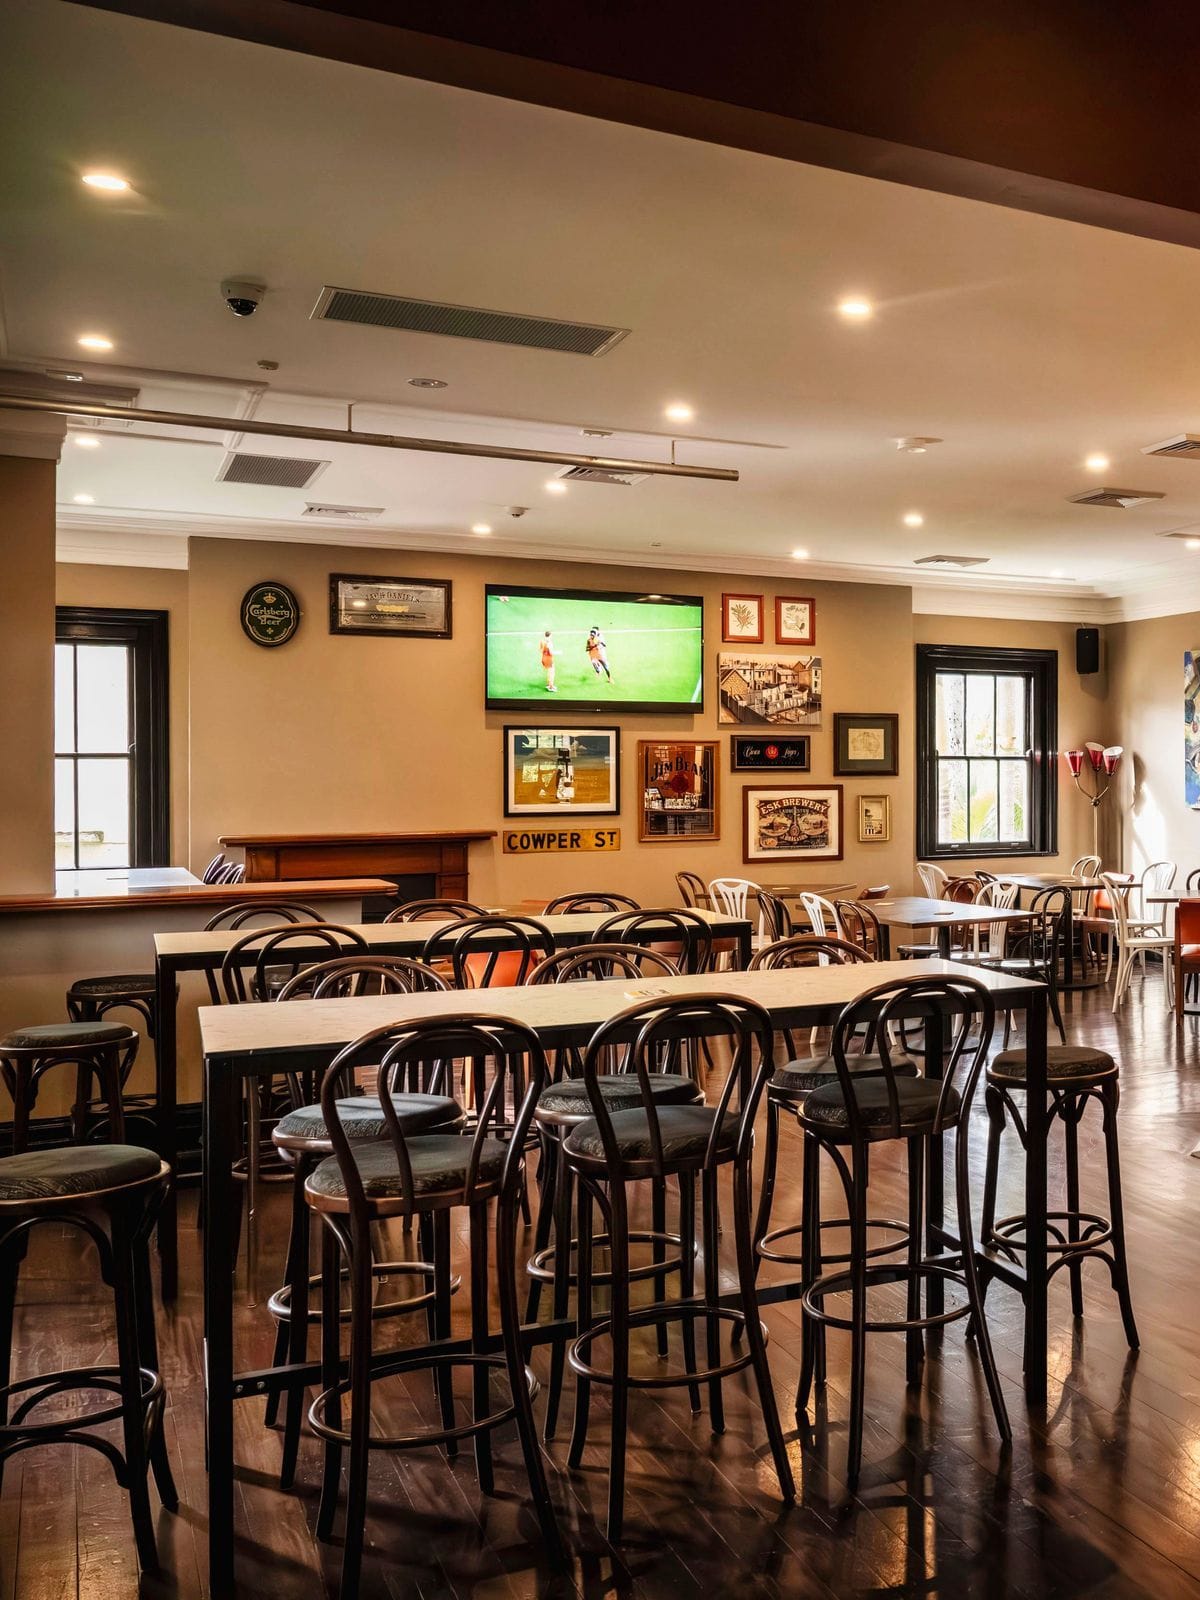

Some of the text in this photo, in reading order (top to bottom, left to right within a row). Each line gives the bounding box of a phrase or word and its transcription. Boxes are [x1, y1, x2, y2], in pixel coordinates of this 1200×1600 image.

[249, 604, 290, 619] Carlsberg
[259, 614, 281, 626] Beer
[651, 755, 709, 784] JIM BEAM
[760, 800, 782, 815] ESK
[782, 798, 828, 813] BREWERY
[507, 831, 617, 850] COWPER ST
